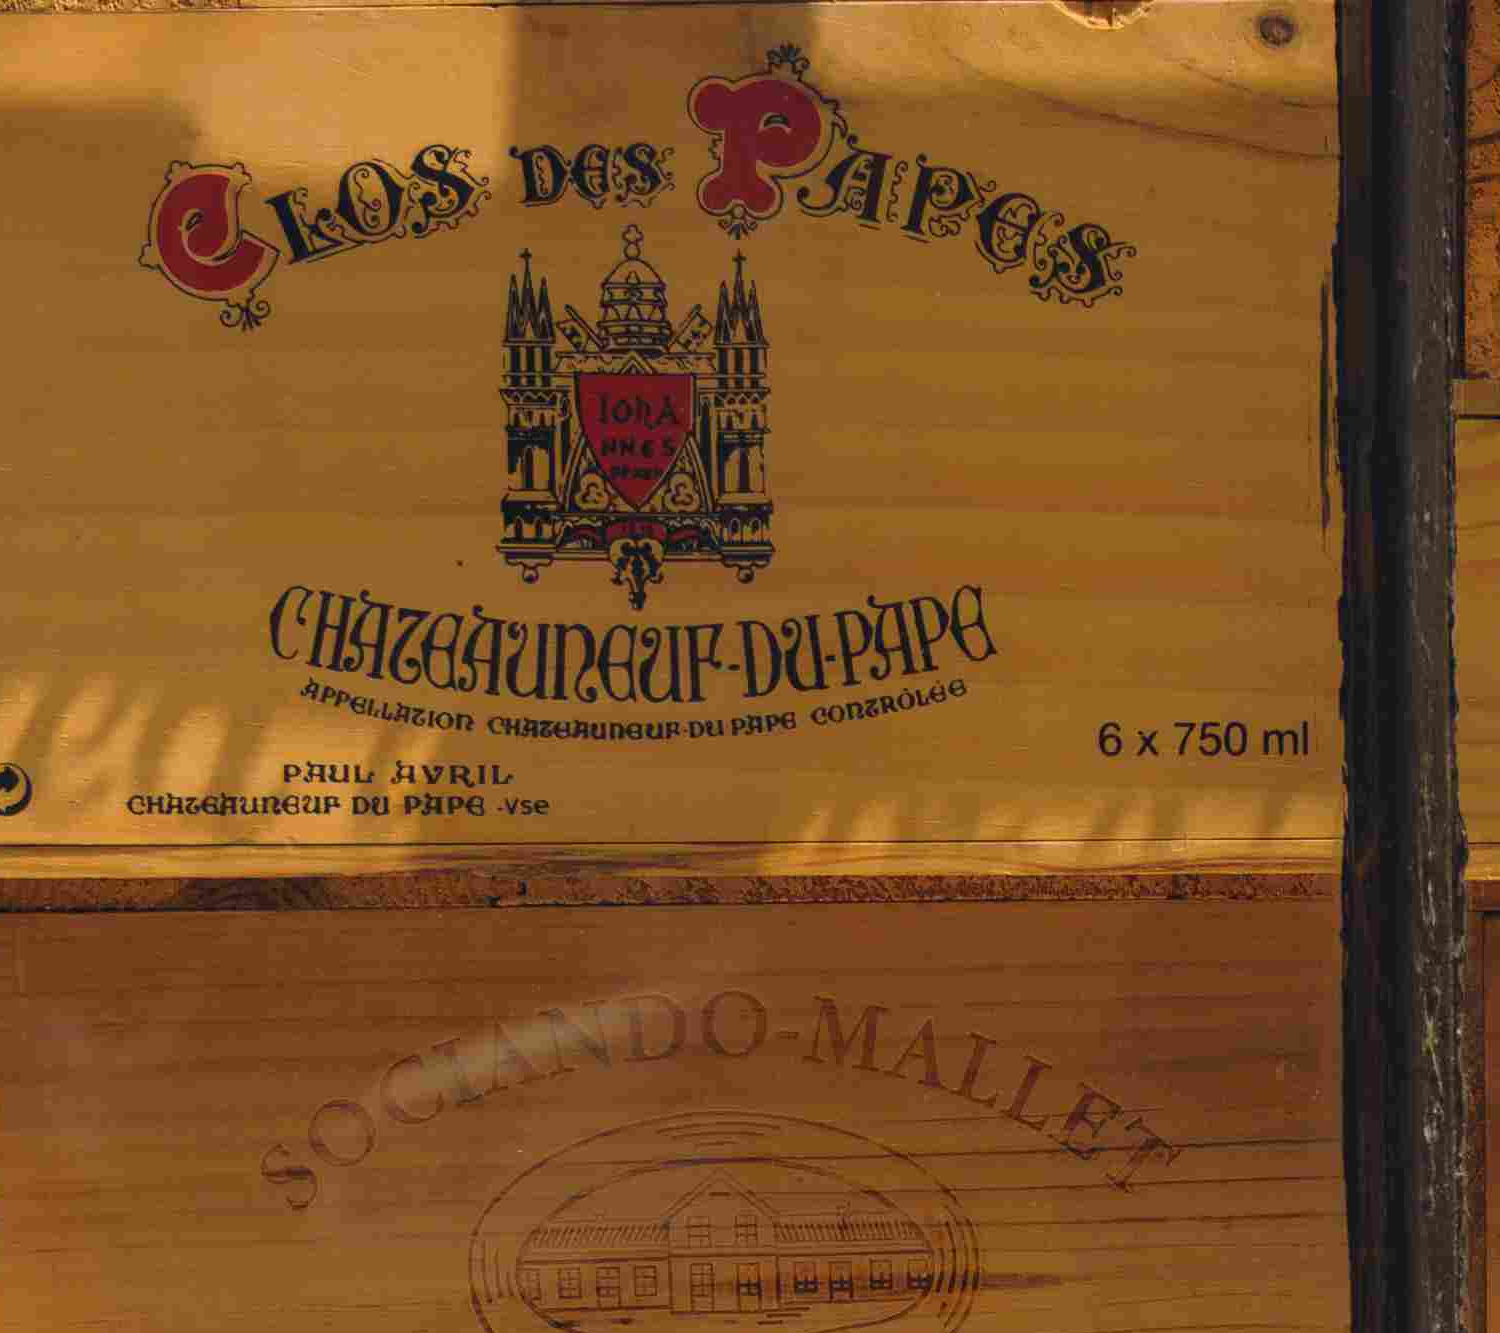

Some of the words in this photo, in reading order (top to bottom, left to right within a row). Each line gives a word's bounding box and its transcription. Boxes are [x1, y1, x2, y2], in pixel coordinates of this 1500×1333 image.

[301, 677, 474, 732] APPELLATION
[1099, 719, 1124, 758] 6
[1136, 729, 1161, 757] x
[1173, 719, 1247, 758] 750
[1263, 718, 1310, 757] ml
[283, 761, 375, 786] PAUL
[391, 759, 514, 788] AVRIL
[351, 795, 389, 817] DU
[403, 794, 485, 817] PAPE
[259, 987, 1183, 1211] SOCIANDO-MALLET
